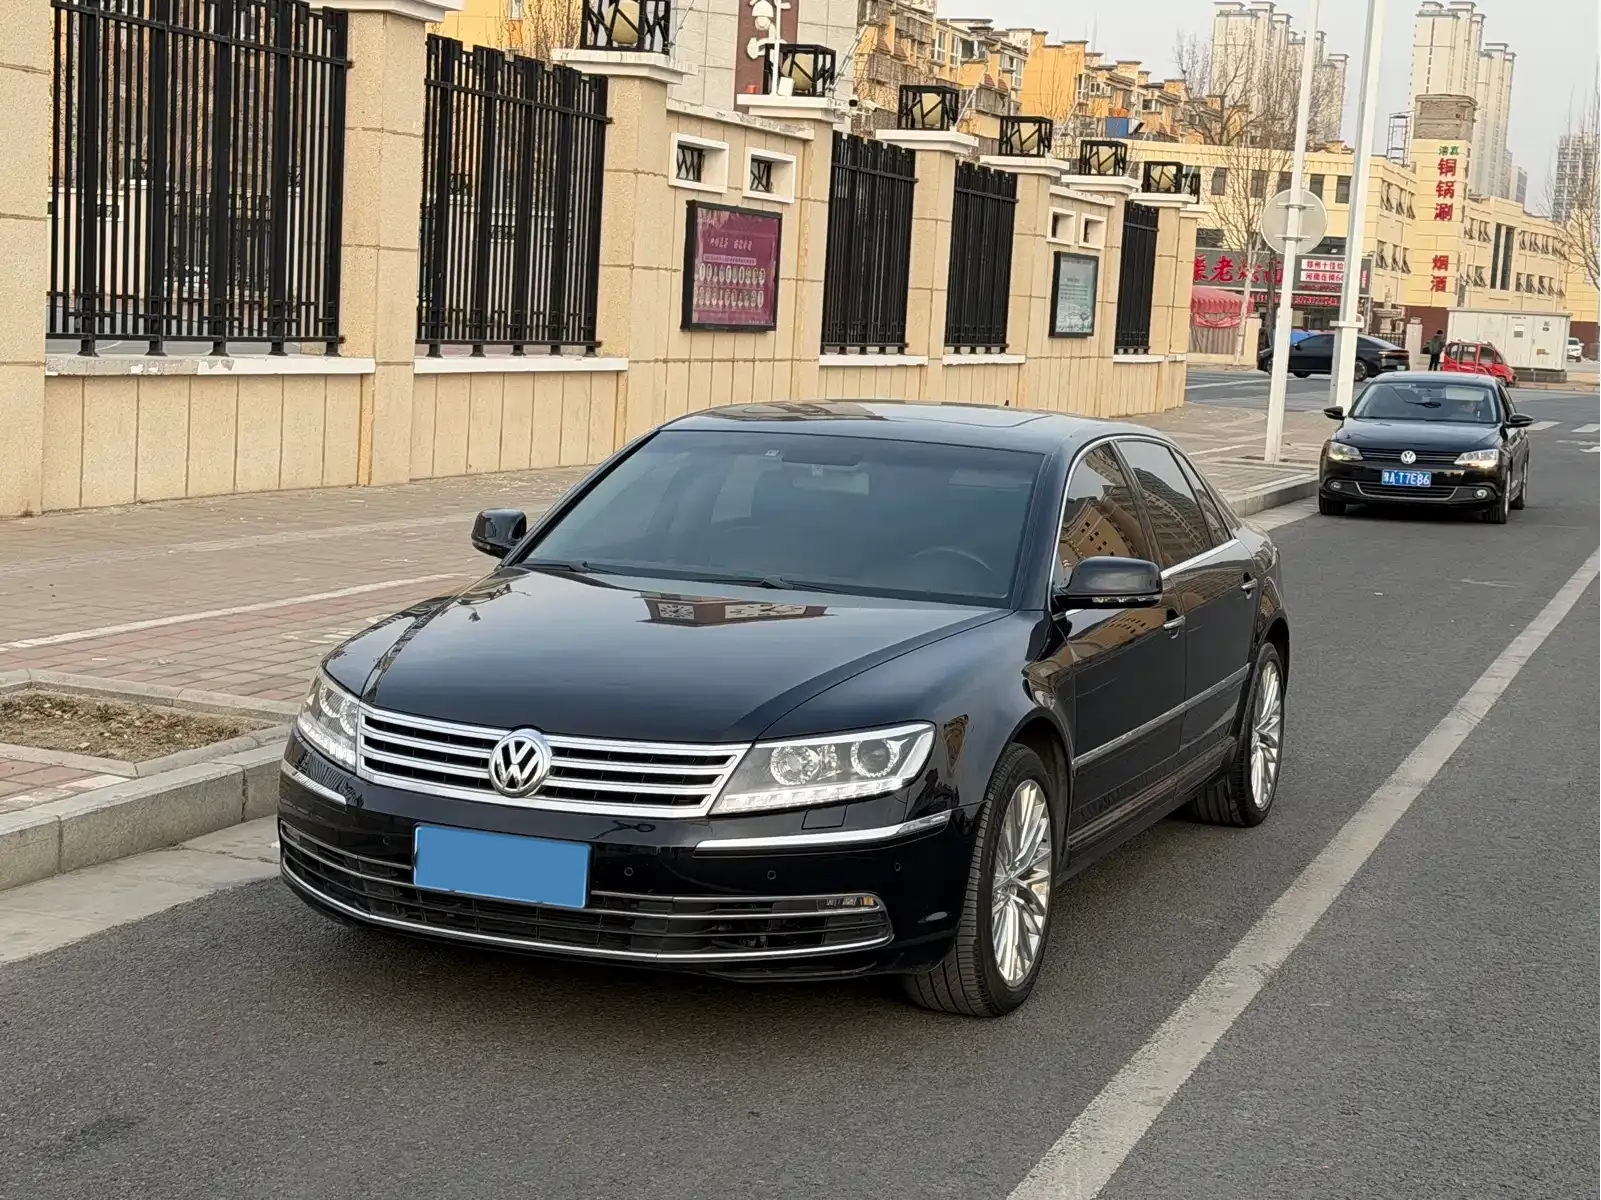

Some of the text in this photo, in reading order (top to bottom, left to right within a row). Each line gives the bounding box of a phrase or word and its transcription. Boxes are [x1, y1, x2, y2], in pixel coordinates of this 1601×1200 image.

[1434, 157, 1457, 222] 铜锅涮
[1430, 254, 1450, 293] 烟酒
[491, 732, 547, 793] VW
